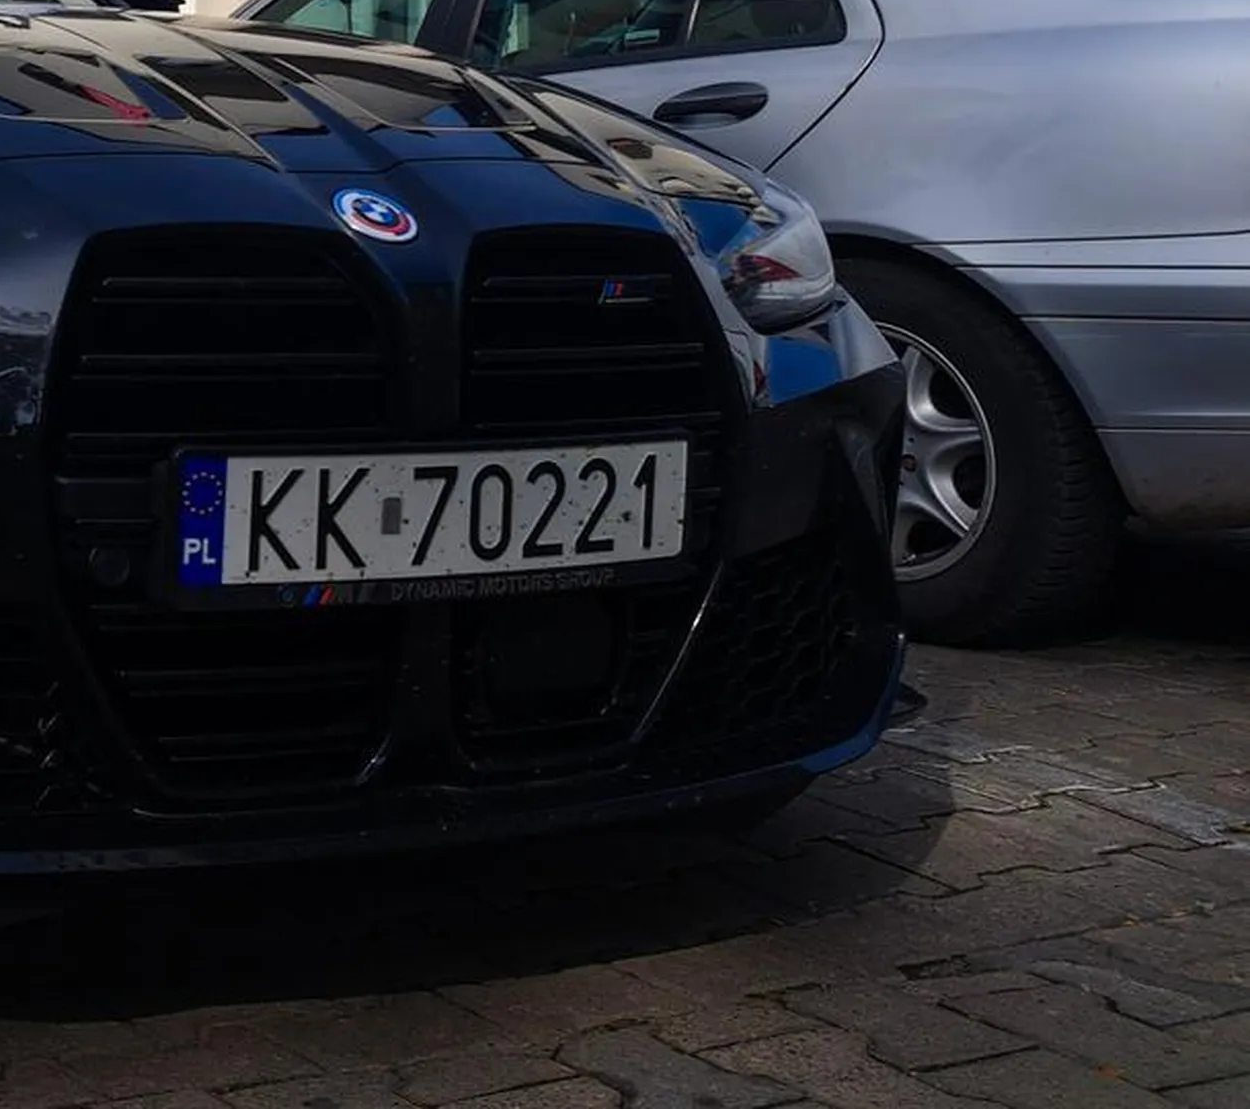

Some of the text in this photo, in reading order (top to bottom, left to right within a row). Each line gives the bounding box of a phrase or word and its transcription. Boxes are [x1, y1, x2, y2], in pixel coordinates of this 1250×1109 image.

[248, 453, 658, 572] KK 70221
[183, 538, 216, 565] PL
